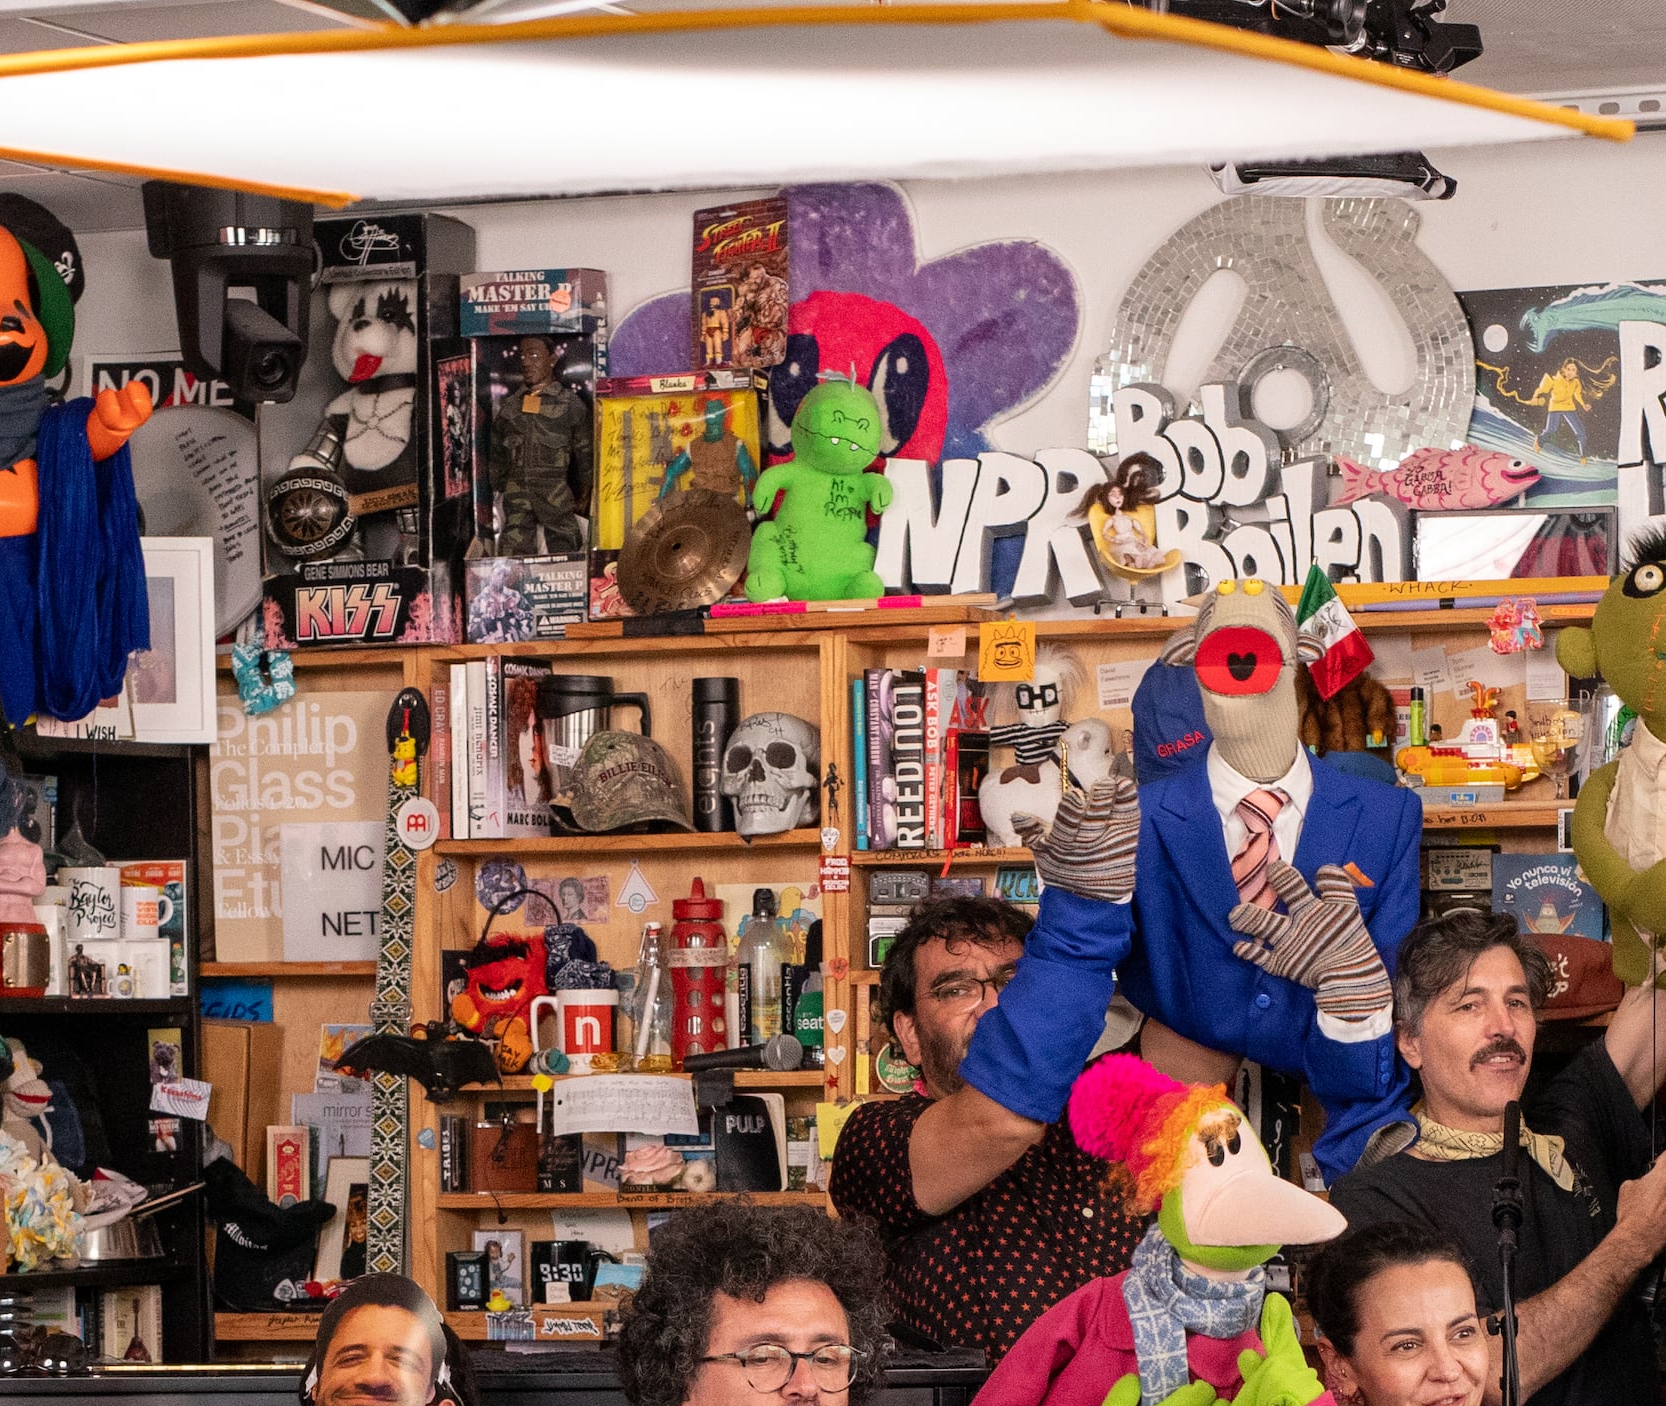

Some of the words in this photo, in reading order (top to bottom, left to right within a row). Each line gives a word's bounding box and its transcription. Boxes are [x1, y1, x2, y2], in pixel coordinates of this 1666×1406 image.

[495, 271, 545, 282] TALKING
[468, 284, 550, 304] MASTER
[474, 303, 500, 314] MAKE
[520, 303, 537, 312] SAY
[1113, 384, 1273, 505] Bob
[875, 448, 1108, 598] NPR
[304, 566, 326, 580] GENE
[328, 564, 365, 579] SIMMONS
[367, 563, 389, 577] BEAR
[539, 571, 583, 581] TALKING
[524, 582, 573, 593] MASTER
[1388, 581, 1464, 594] WHACK
[296, 583, 401, 640] KISS
[434, 689, 445, 703] ED
[488, 676, 498, 712] COSMIC
[926, 681, 938, 714] ASK
[434, 704, 445, 734] CRAY
[868, 699, 881, 736] CONSTANT
[86, 725, 116, 741] WISH
[216, 702, 358, 766] Philip
[488, 715, 498, 760] DANCER
[926, 717, 938, 749] BOB
[1157, 730, 1205, 760] GRASA
[213, 757, 356, 811] Glass
[599, 761, 639, 785] BILLIE
[506, 812, 530, 826] MARC
[894, 764, 925, 848] REED
[320, 844, 376, 871] MIC
[1506, 874, 1523, 889] Yo
[1522, 864, 1556, 881] nunca
[1557, 864, 1572, 876] vi
[1524, 872, 1583, 897] televisión
[75, 905, 117, 930] Project
[321, 910, 381, 937] NET
[739, 966, 749, 1032] essentia
[574, 1015, 601, 1046] n
[797, 1015, 824, 1031] seat
[323, 1103, 363, 1120] mirror
[725, 1114, 766, 1135] PULP
[441, 1127, 451, 1181] TRIBES
[538, 1262, 584, 1284] 9:30
